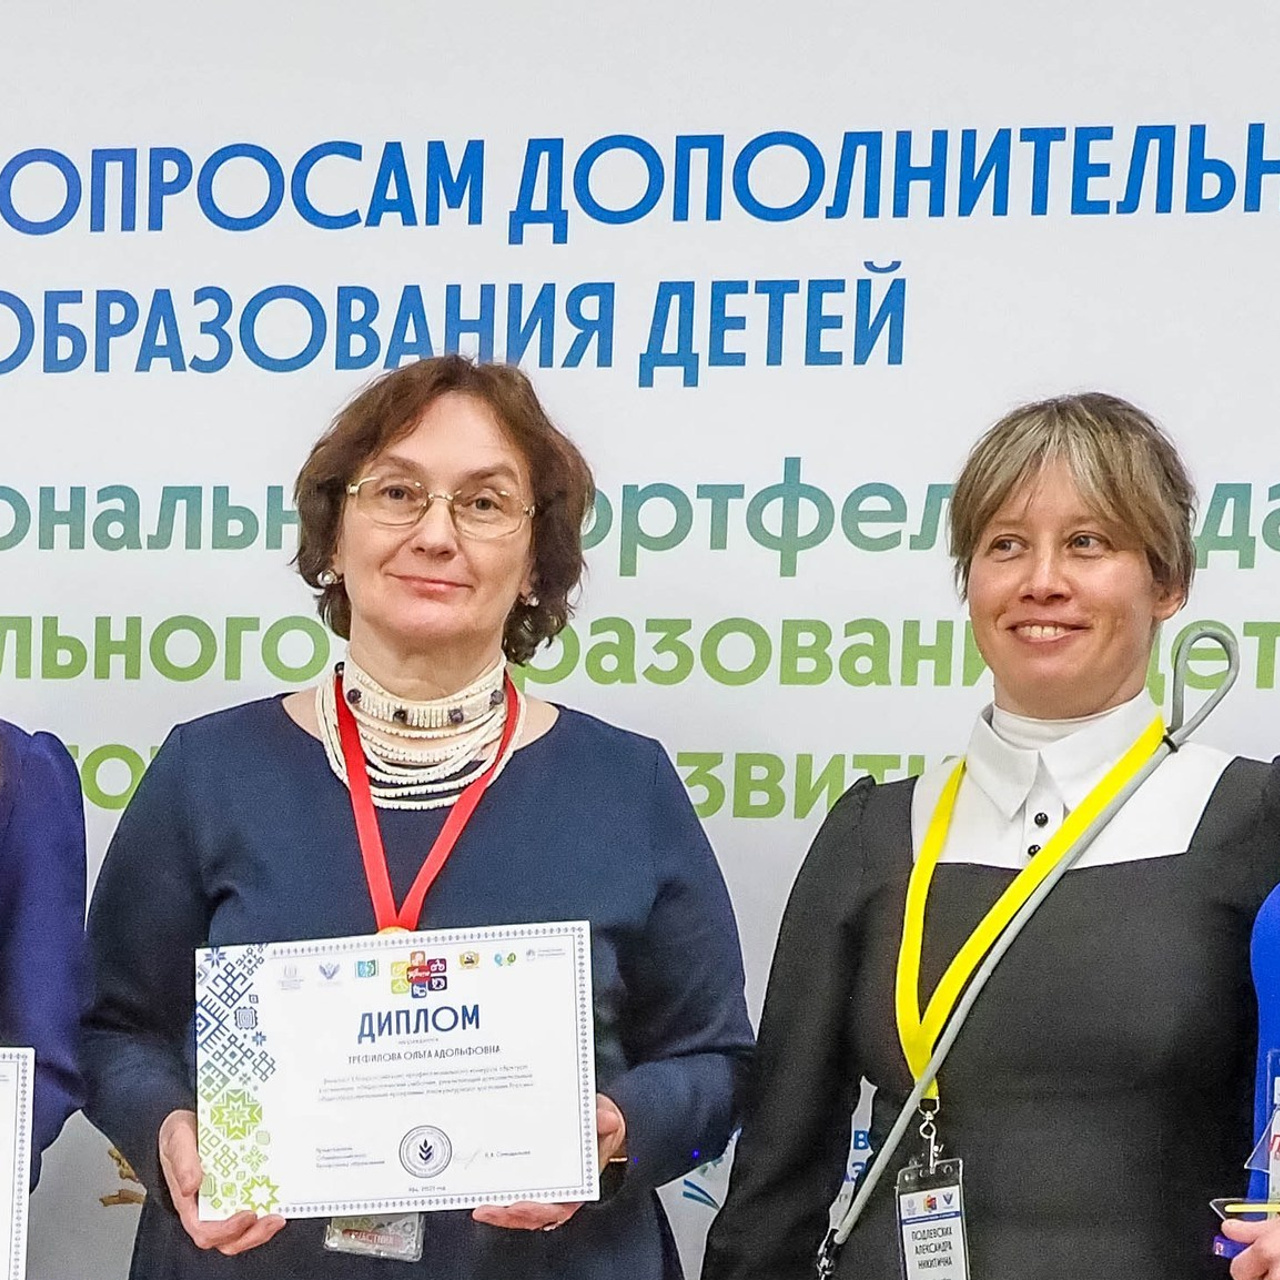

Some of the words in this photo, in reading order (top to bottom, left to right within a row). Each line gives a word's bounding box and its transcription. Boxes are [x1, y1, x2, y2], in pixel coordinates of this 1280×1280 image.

[508, 123, 1280, 244] ДОПОЛНИТЕЛЬН
[638, 260, 907, 388] ДЕТЕЙ
[357, 1004, 480, 1044] ДИПЛОМ
[403, 1049, 433, 1061] ОЛЬГА
[433, 1045, 500, 1059] АДОЛЬФОВНА
